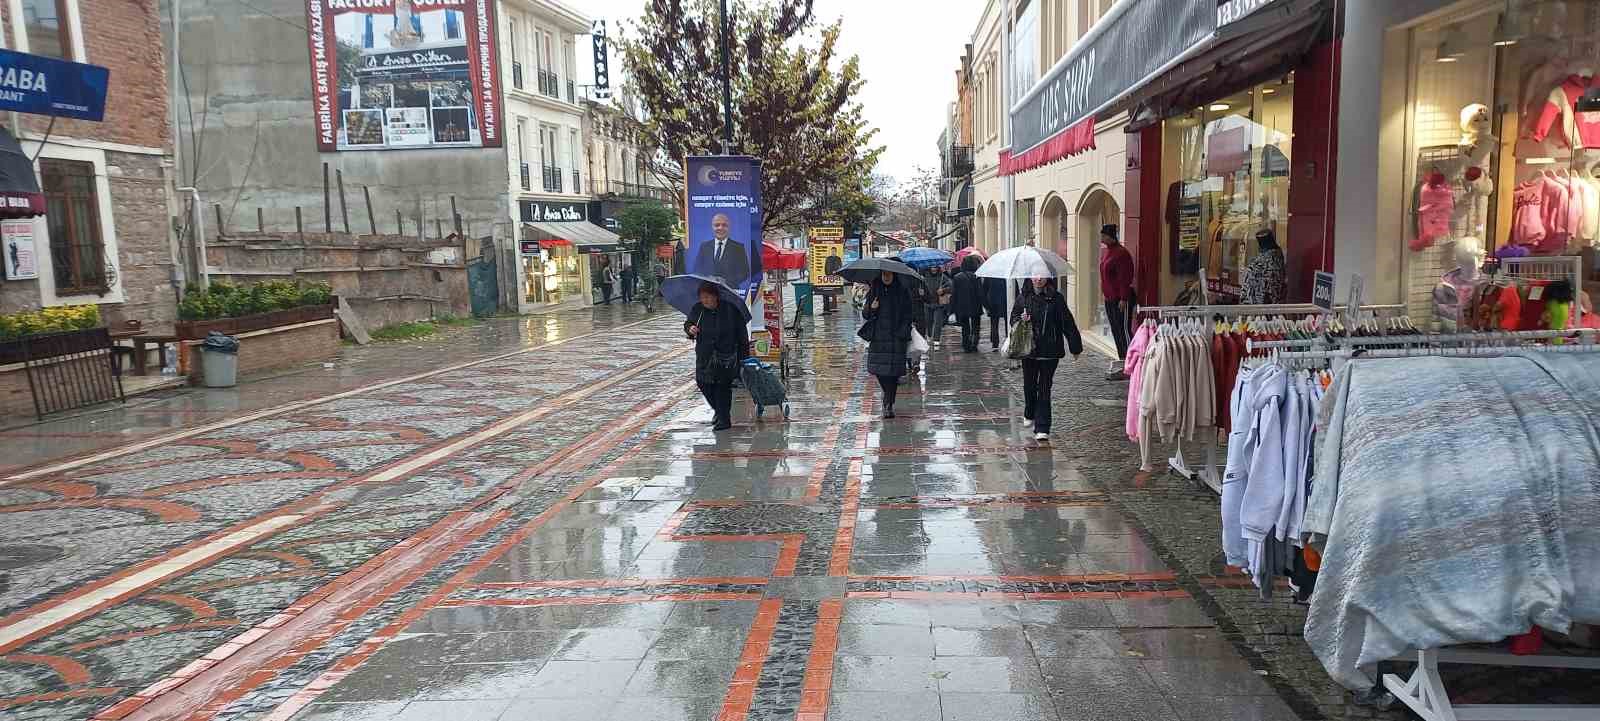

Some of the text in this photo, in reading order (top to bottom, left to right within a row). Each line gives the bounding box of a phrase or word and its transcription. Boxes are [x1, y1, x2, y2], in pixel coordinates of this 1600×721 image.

[316, 61, 329, 93] SATIŞ
[1064, 47, 1096, 122] SHOP
[319, 95, 333, 144] FABRİKA
